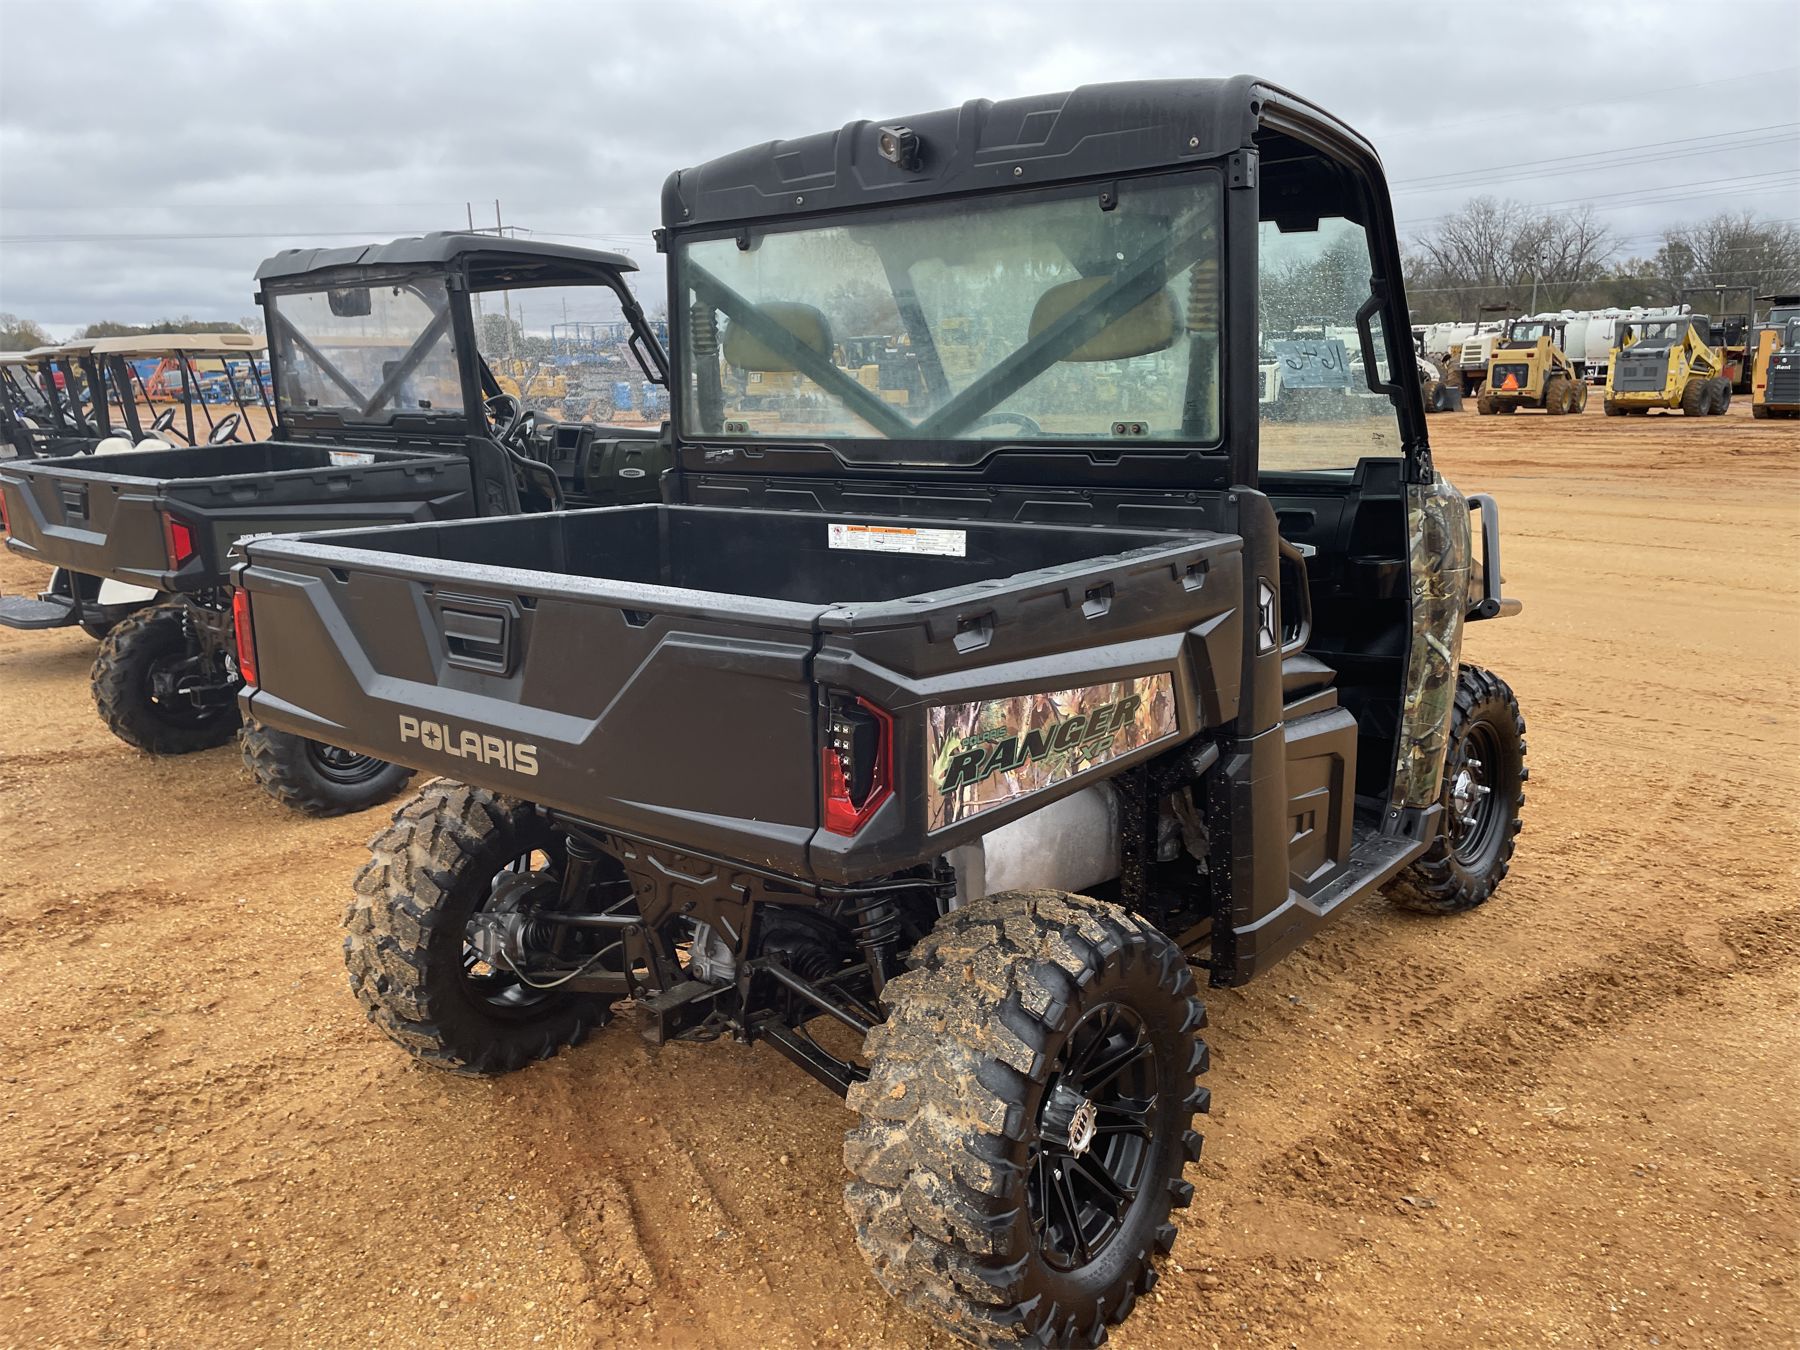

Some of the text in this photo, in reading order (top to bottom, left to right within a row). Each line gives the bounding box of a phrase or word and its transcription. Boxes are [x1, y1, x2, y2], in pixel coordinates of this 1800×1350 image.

[399, 714, 539, 776] POLARIS
[940, 694, 1142, 796] RANGER
[961, 726, 1008, 748] POLARIS
[1073, 735, 1114, 766] XP
